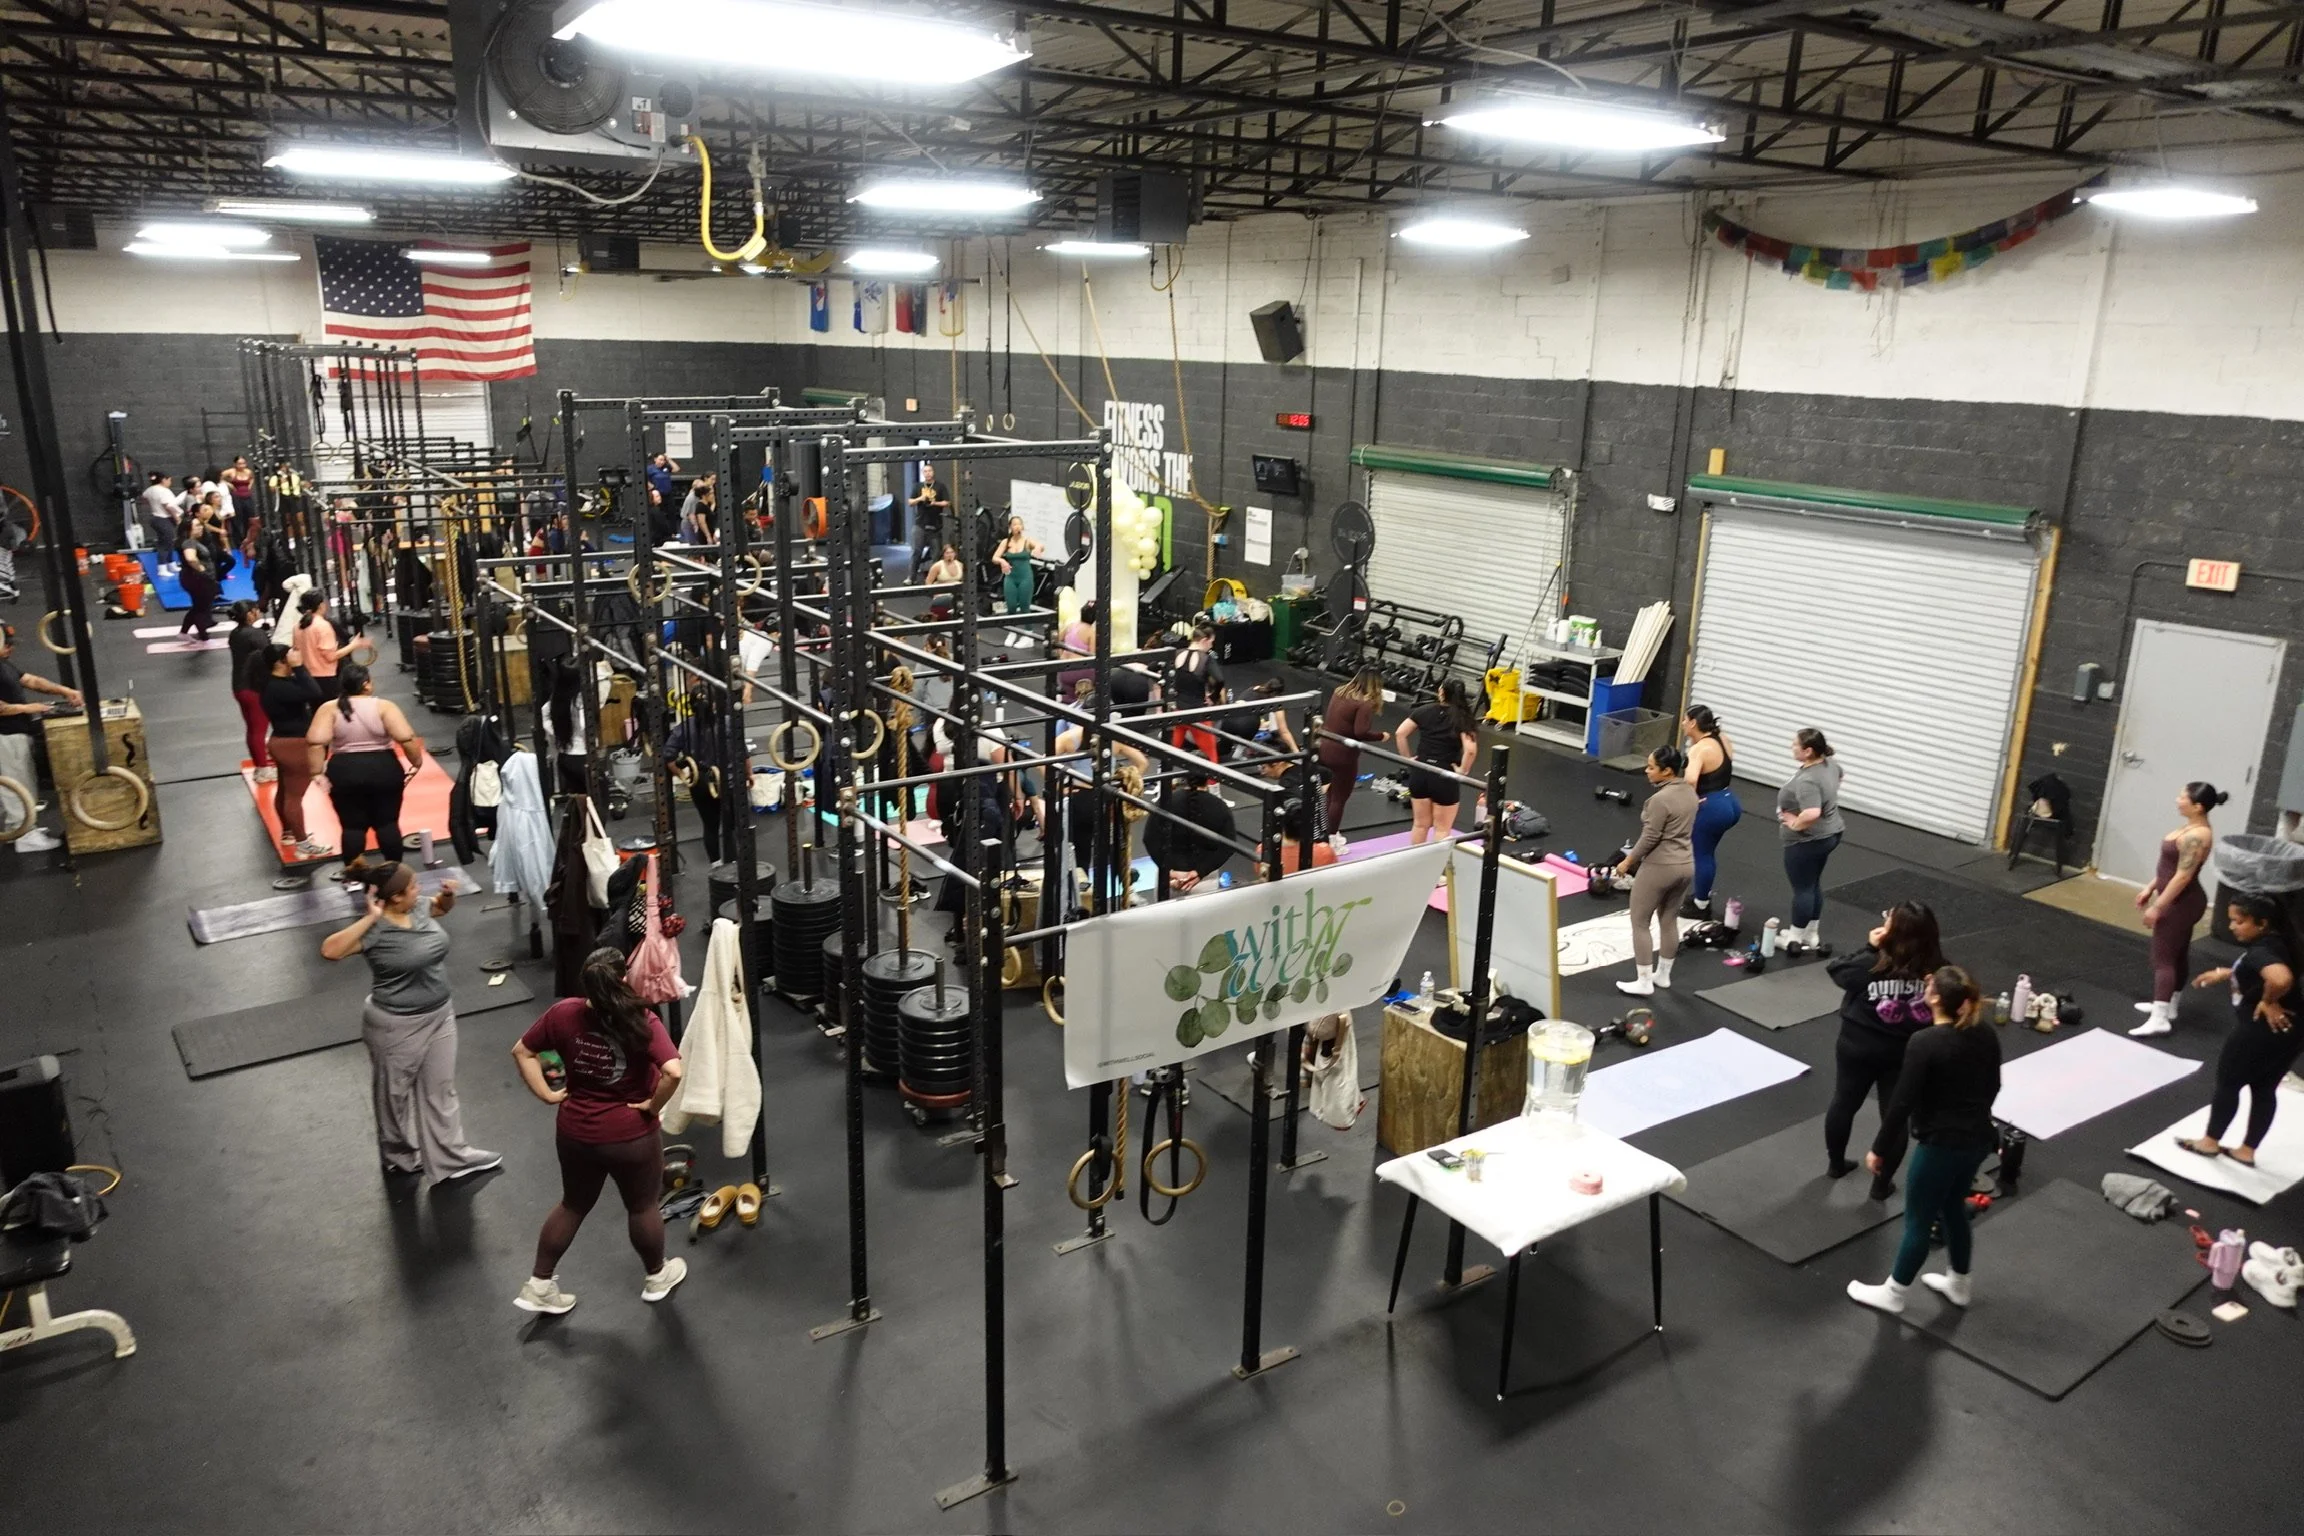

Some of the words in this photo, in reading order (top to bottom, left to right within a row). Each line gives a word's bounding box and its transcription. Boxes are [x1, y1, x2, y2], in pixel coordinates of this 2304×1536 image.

[1104, 400, 1165, 450] FITNESS
[2196, 562, 2231, 586] EXIT
[1224, 888, 1334, 961] with
[1867, 979, 1925, 1001] gymsh
